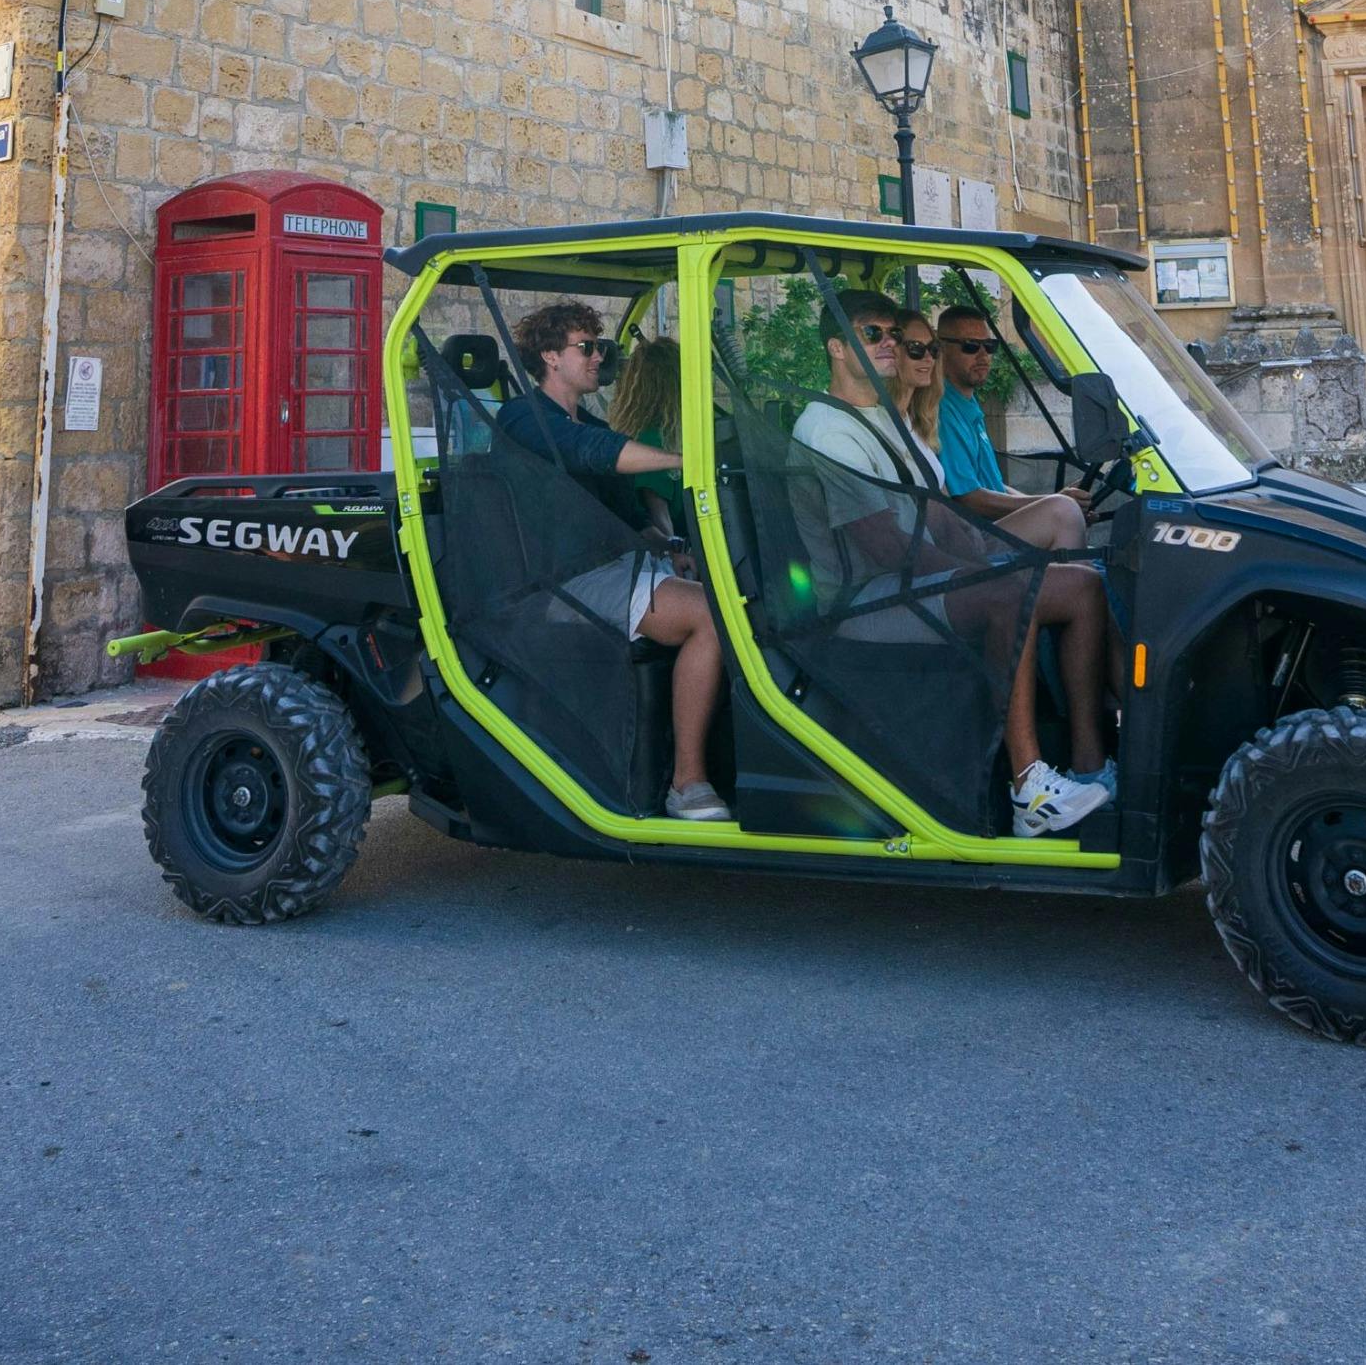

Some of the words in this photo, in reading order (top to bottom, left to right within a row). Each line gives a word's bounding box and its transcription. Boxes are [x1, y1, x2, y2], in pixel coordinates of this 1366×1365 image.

[285, 215, 365, 237] TELEPHONE
[1147, 498, 1183, 513] EPS
[177, 516, 359, 559] SEGWAY
[1152, 521, 1242, 552] 1000
